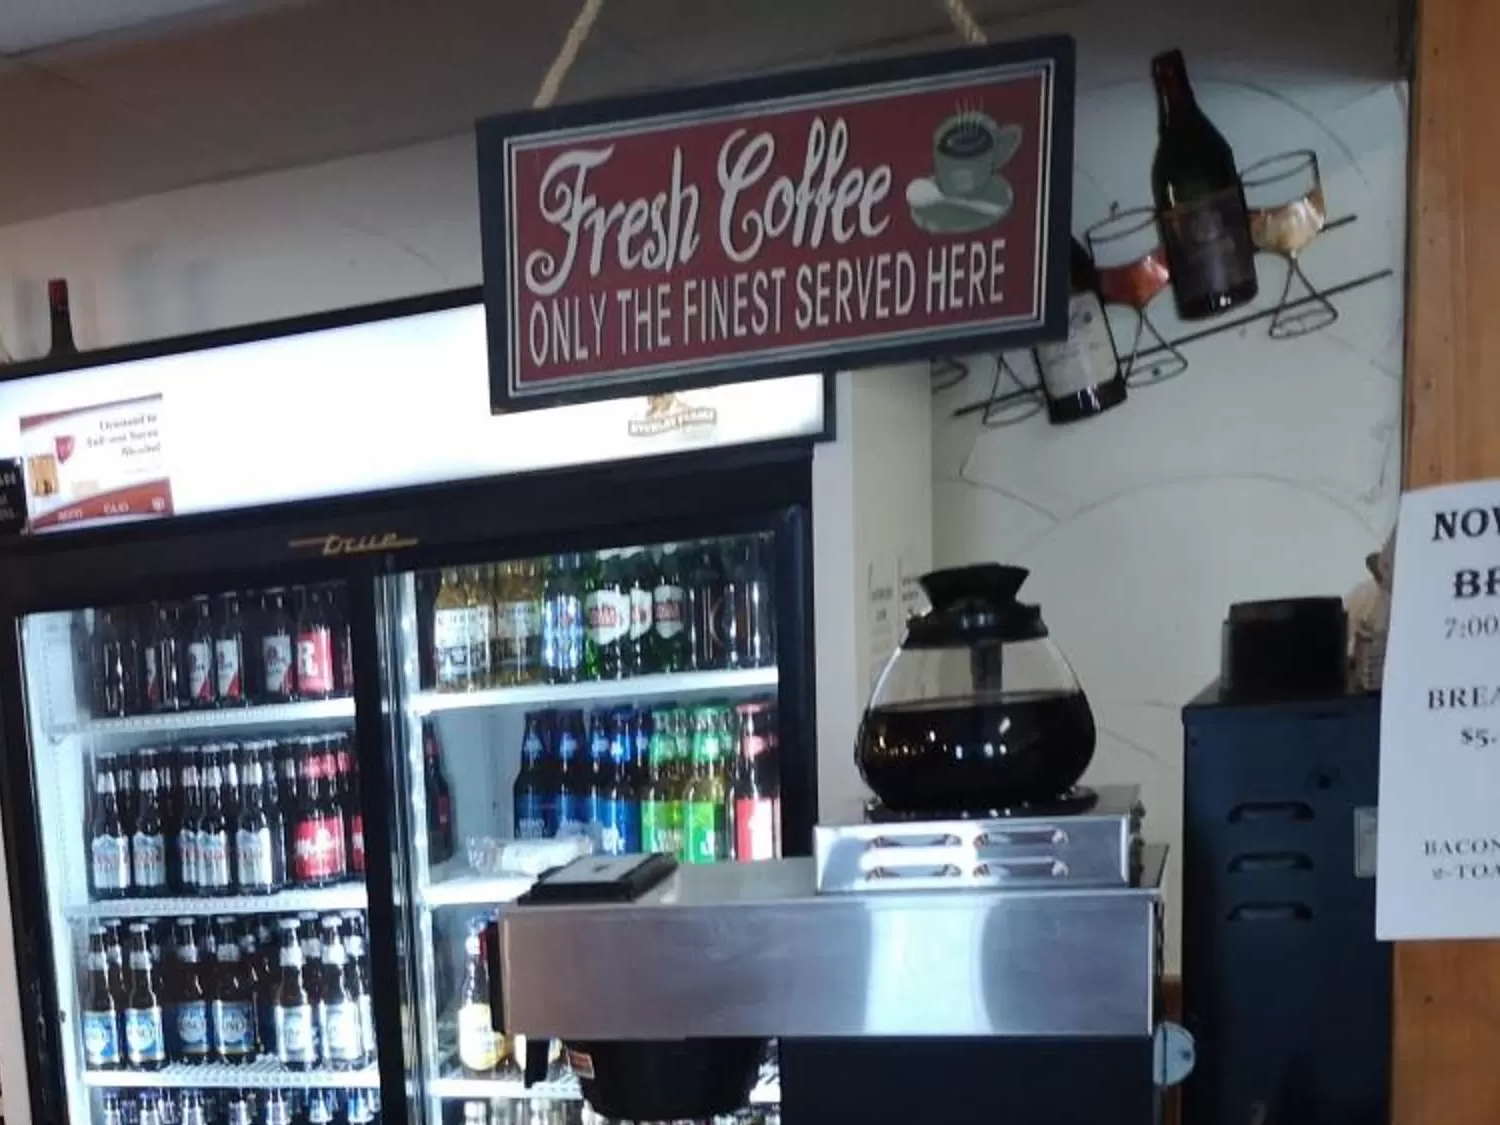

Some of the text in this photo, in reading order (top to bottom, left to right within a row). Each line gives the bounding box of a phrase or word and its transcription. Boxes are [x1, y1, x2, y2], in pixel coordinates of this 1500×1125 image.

[525, 115, 892, 296] Fresh Coffee
[529, 238, 1007, 367] ONLY THE FINEST SERVED HERE
[1432, 506, 1500, 542] NO
[1444, 614, 1500, 640] 7:00
